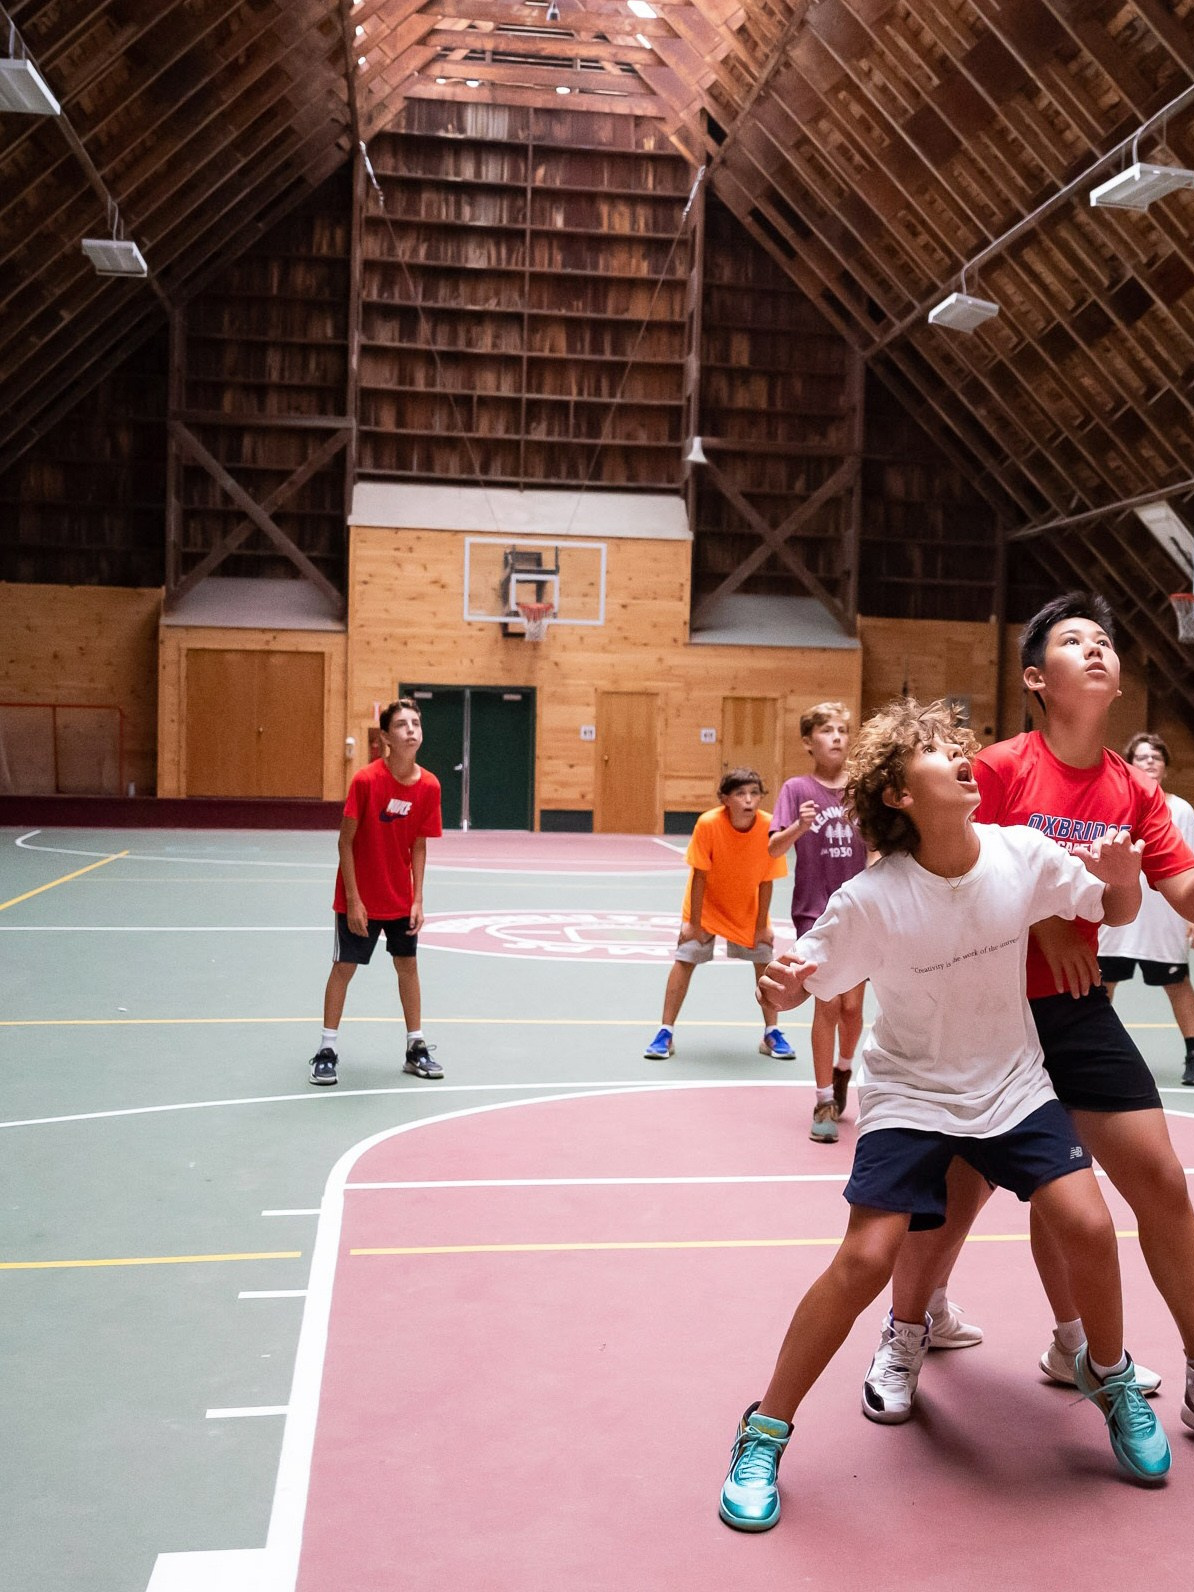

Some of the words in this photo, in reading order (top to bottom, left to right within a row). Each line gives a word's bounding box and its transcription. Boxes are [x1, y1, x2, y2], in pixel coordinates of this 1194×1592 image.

[386, 798, 412, 816] NIKE
[829, 846, 853, 858] 1930
[962, 949, 978, 960] work
[980, 946, 988, 955] of
